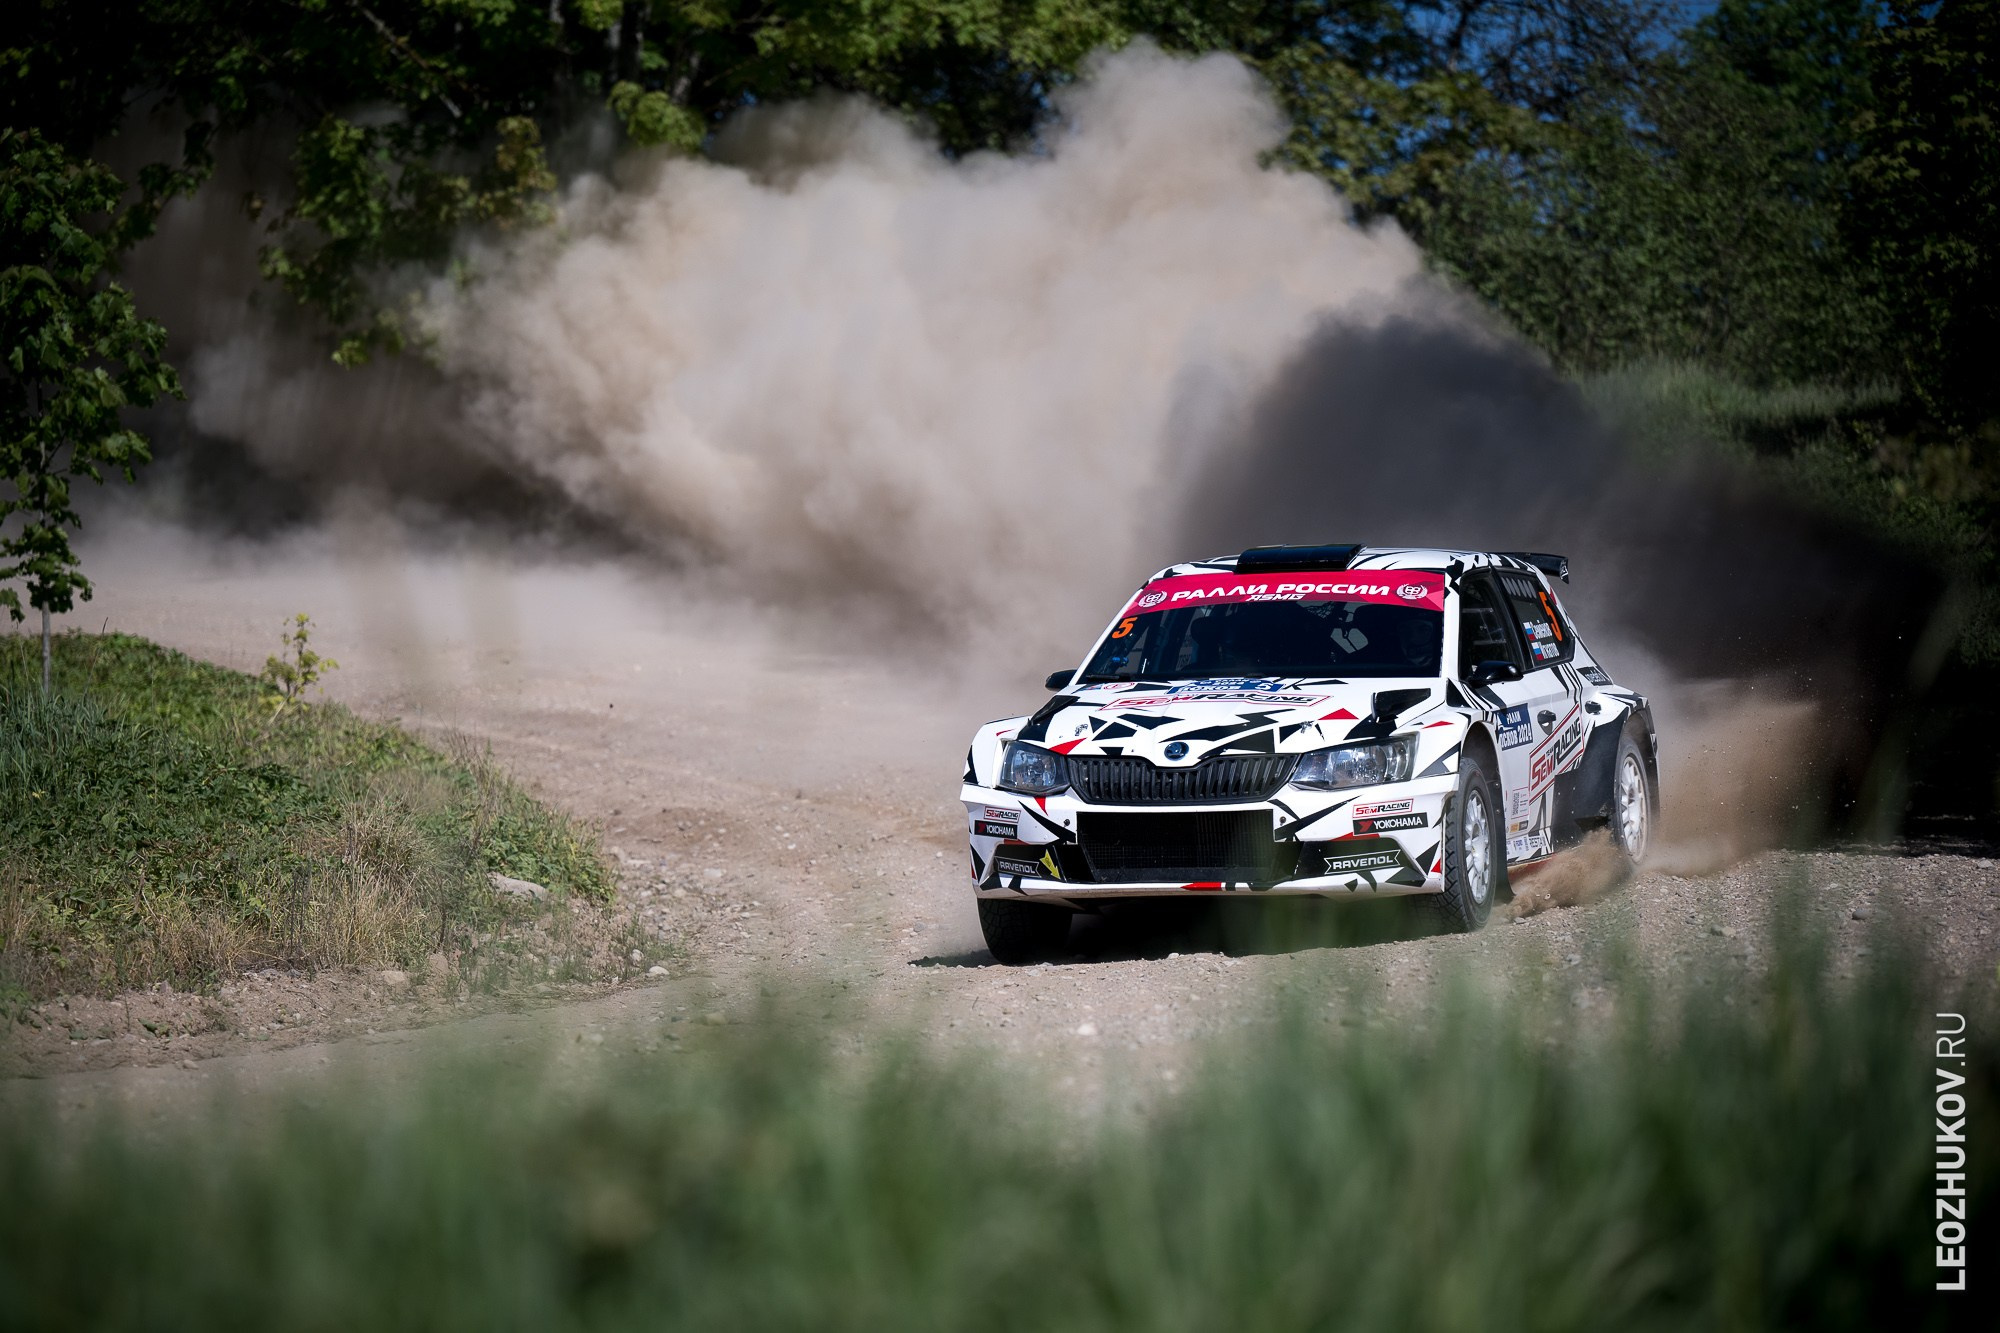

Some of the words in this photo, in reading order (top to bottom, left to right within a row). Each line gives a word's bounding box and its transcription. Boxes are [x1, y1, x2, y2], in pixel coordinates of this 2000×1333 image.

[1171, 584, 1269, 602] РАЛЛИ
[1275, 583, 1390, 596] РОССИИ
[1538, 591, 1563, 641] 5
[1111, 617, 1138, 639] 5
[1518, 723, 1532, 743] 2024
[986, 824, 1015, 836] YOKOHAMA
[1373, 816, 1423, 830] YOKOHAMA
[999, 861, 1036, 874] RAVENOL
[1332, 855, 1394, 870] RAVENOL
